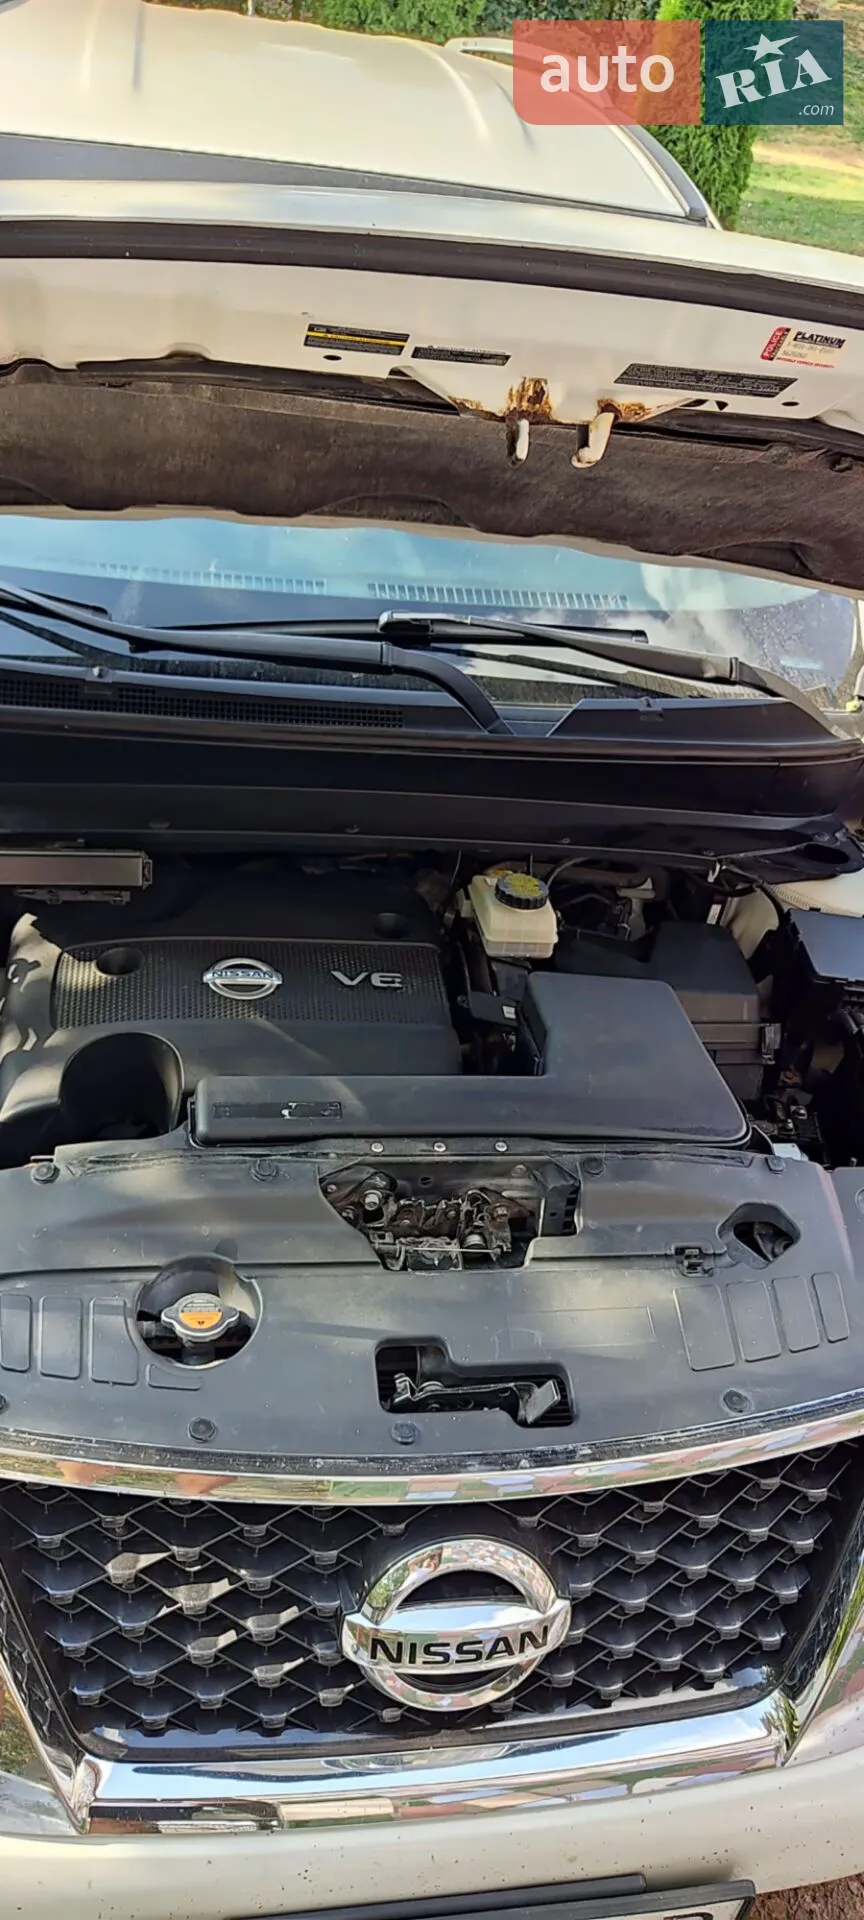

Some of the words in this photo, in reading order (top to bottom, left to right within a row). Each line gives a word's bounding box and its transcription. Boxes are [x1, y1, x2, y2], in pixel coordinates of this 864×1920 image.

[793, 331, 846, 349] PLATINUM
[211, 969, 275, 979] NISSAN
[330, 970, 404, 988] V6
[369, 1624, 549, 1666] NISSAN
